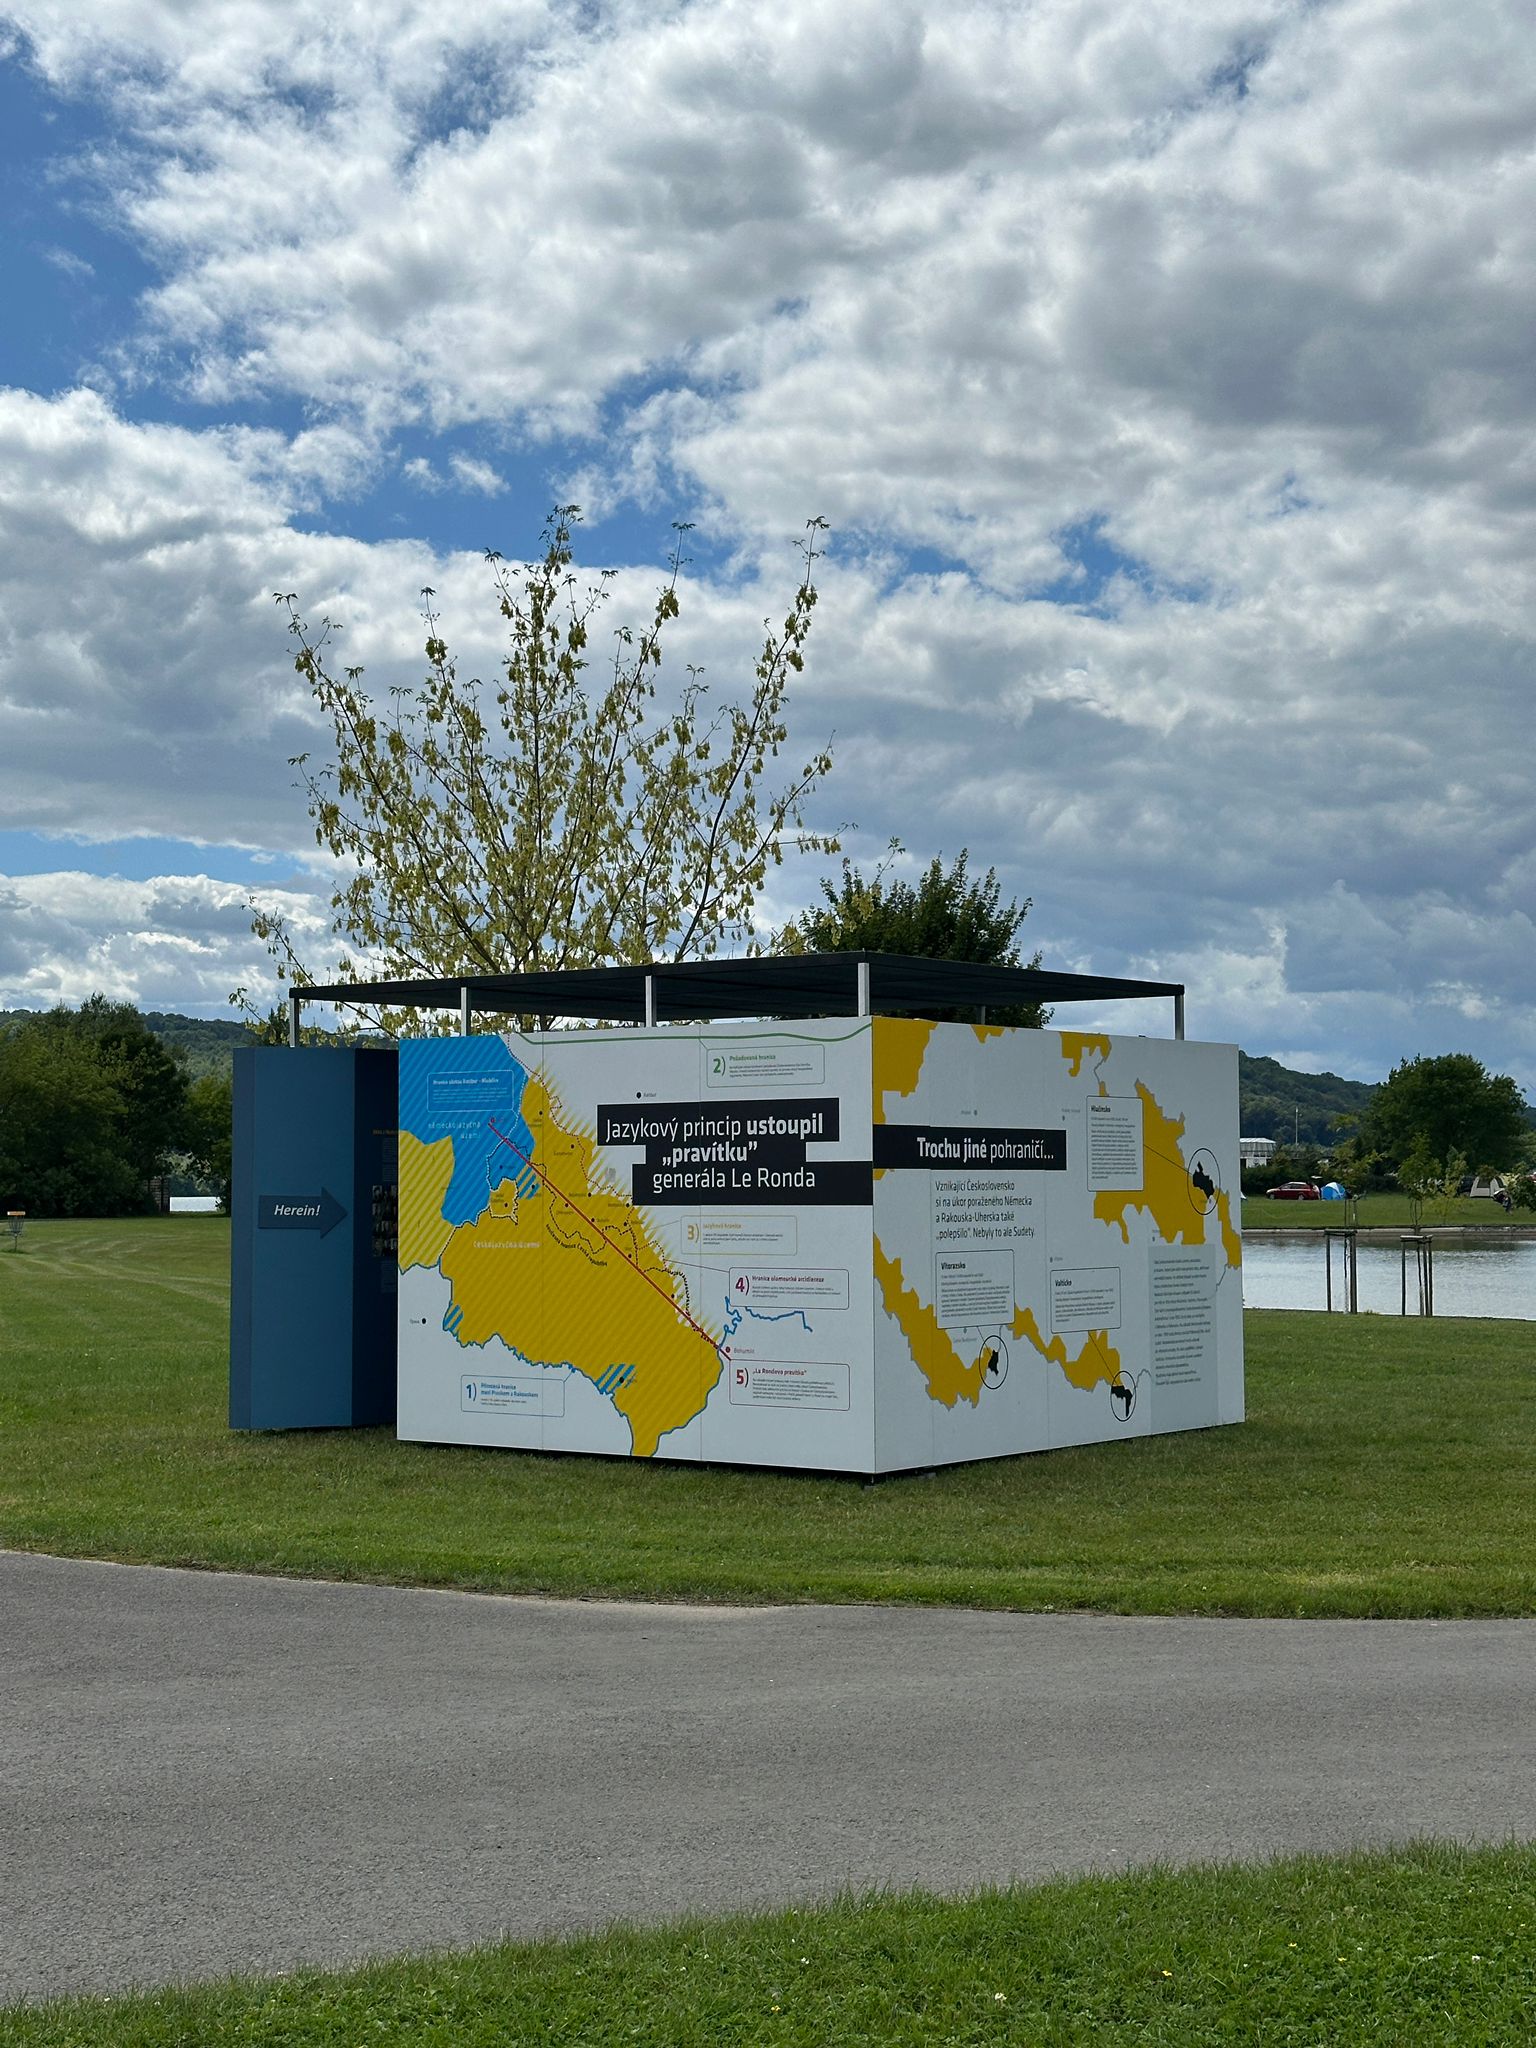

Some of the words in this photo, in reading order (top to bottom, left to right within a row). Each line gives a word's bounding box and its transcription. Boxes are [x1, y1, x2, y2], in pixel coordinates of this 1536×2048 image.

[605, 1117, 679, 1142] Jazykový
[683, 1115, 742, 1142] princip
[747, 1112, 823, 1139] ustoupil
[917, 1137, 961, 1159] Trochu
[963, 1137, 987, 1163] jiné
[990, 1139, 1054, 1163] pohraničí...
[653, 1167, 726, 1194] generála
[732, 1170, 751, 1188] Le
[757, 1167, 816, 1188] Ronda
[935, 1180, 966, 1193] Vznikající
[966, 1179, 1015, 1191] Československo
[935, 1197, 941, 1207] si
[942, 1199, 951, 1207] na
[952, 1197, 966, 1207] úkor
[967, 1196, 1003, 1209] poraženého
[1004, 1195, 1032, 1206] Německa
[274, 1204, 321, 1217] Herein!
[935, 1214, 940, 1223] a
[941, 1212, 1000, 1223] Rakouska-Uherska
[1000, 1211, 1015, 1222] také
[973, 1227, 994, 1240] Nebyly
[995, 1228, 1002, 1237] to
[1003, 1227, 1013, 1237] ale
